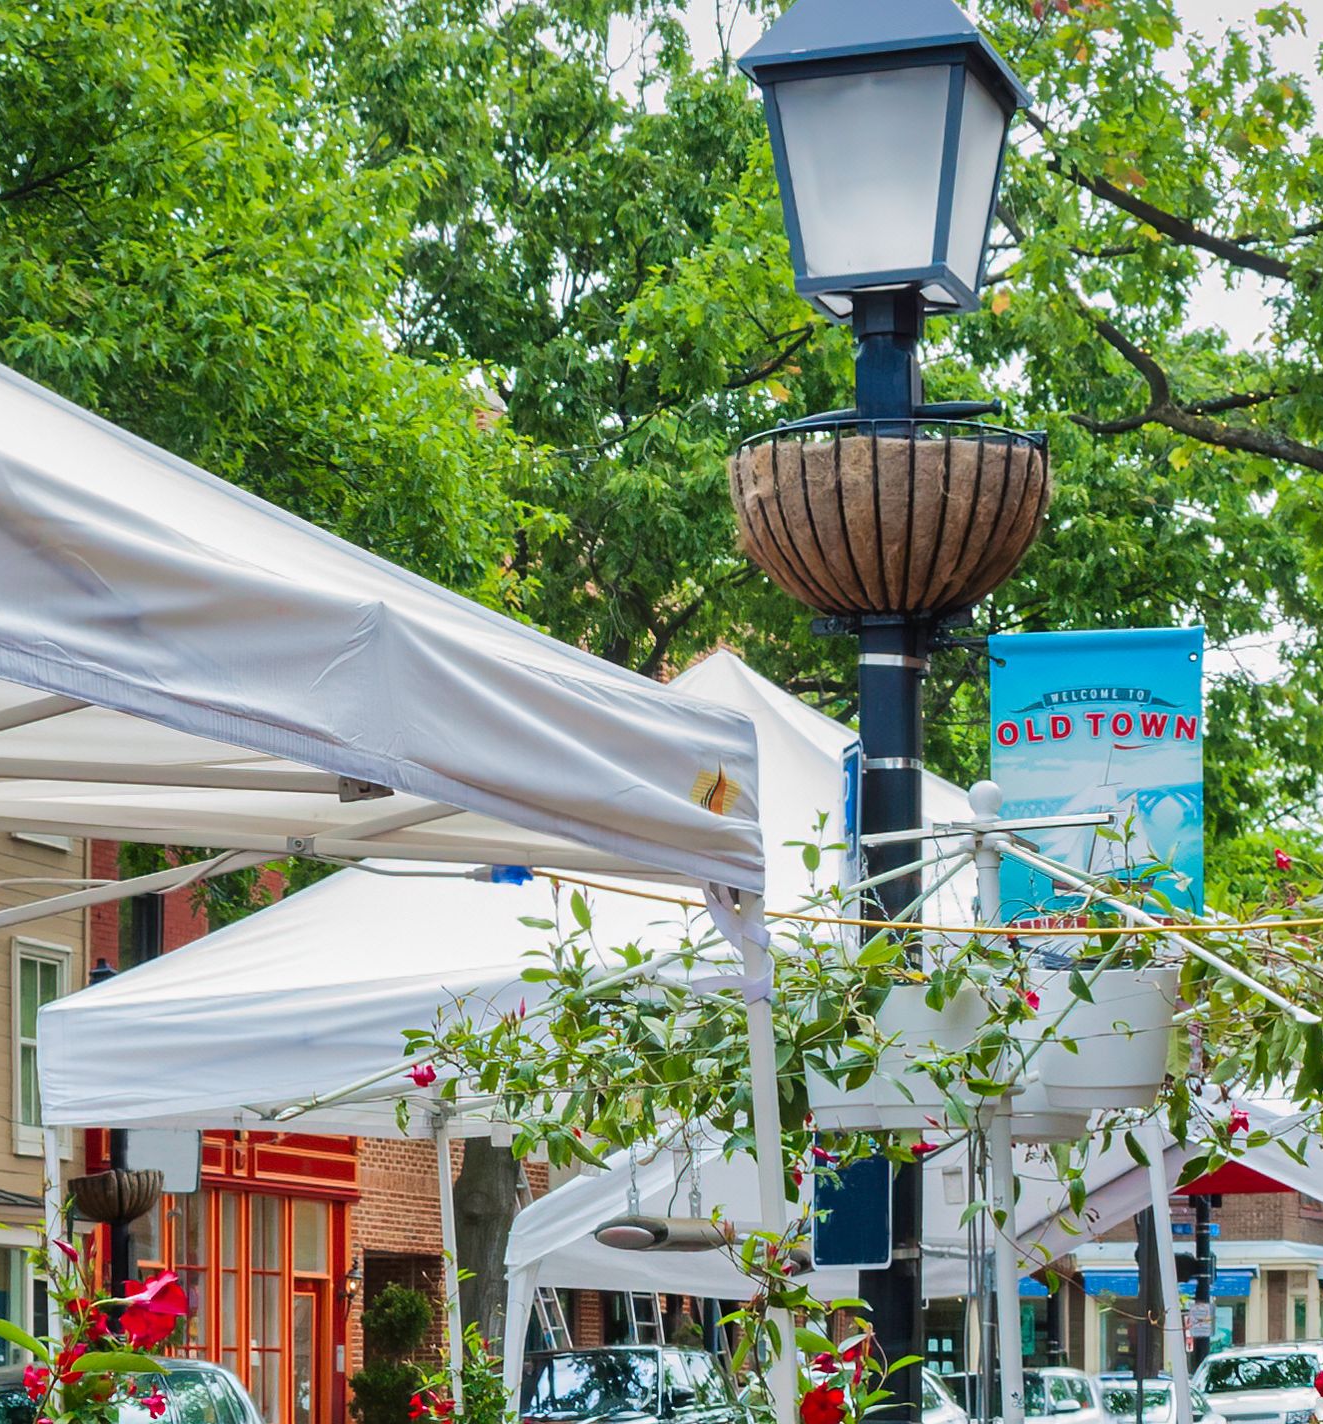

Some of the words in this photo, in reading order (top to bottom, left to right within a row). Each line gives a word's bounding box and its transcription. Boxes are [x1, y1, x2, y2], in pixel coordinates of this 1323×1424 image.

[1050, 689, 1118, 703] WELCOME
[1129, 689, 1145, 700] TO
[997, 715, 1072, 746] OLD
[1085, 712, 1198, 741] TOWN
